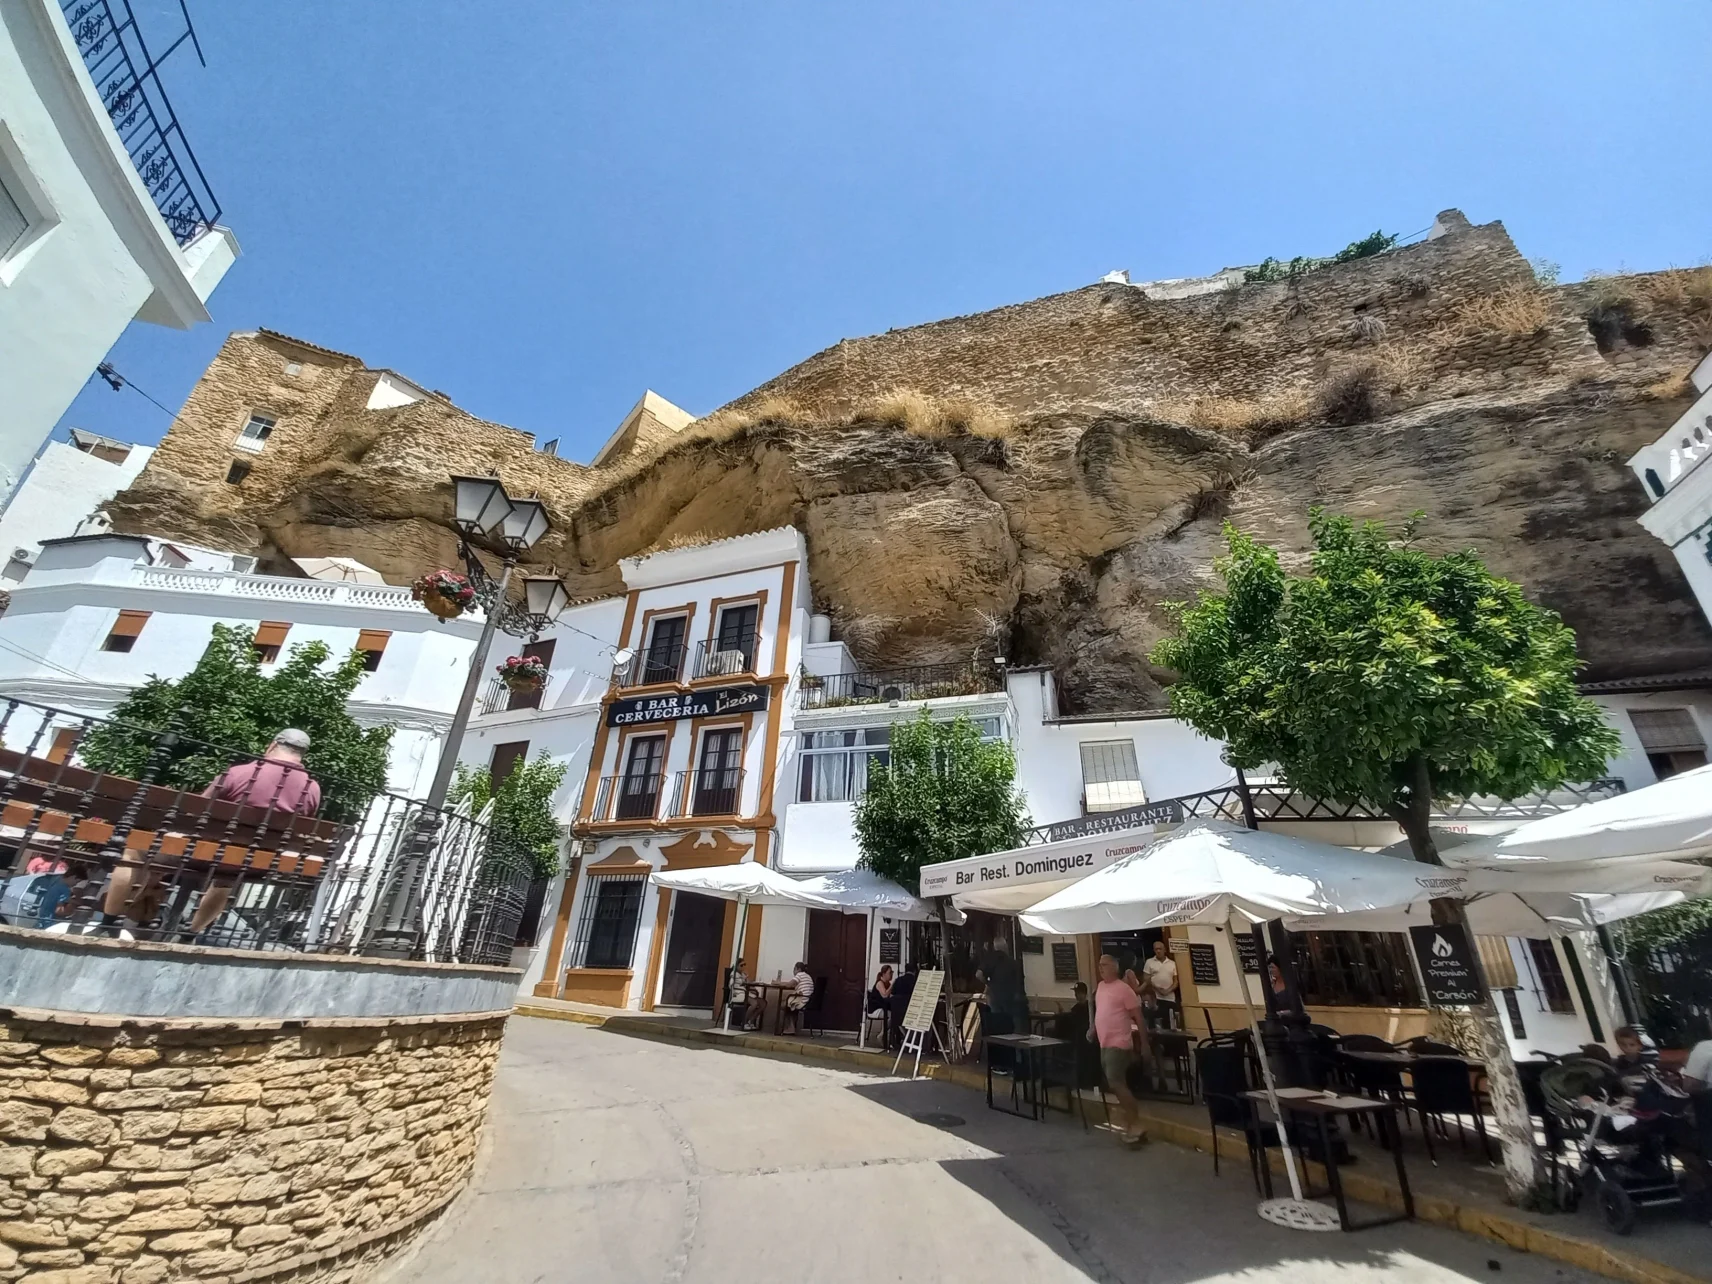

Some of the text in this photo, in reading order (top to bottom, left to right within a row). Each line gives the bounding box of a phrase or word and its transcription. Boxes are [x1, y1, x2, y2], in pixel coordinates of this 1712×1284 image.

[648, 697, 678, 710] BAR
[715, 692, 759, 713] Lizón
[615, 704, 709, 724] CERVECERIA
[1055, 825, 1076, 836] BAR
[1086, 806, 1174, 830] RESTAURANTE
[956, 871, 975, 885] Bar
[980, 865, 1010, 882] Rest.
[1015, 853, 1094, 876] Dominguez
[1431, 959, 1461, 967] Carnes
